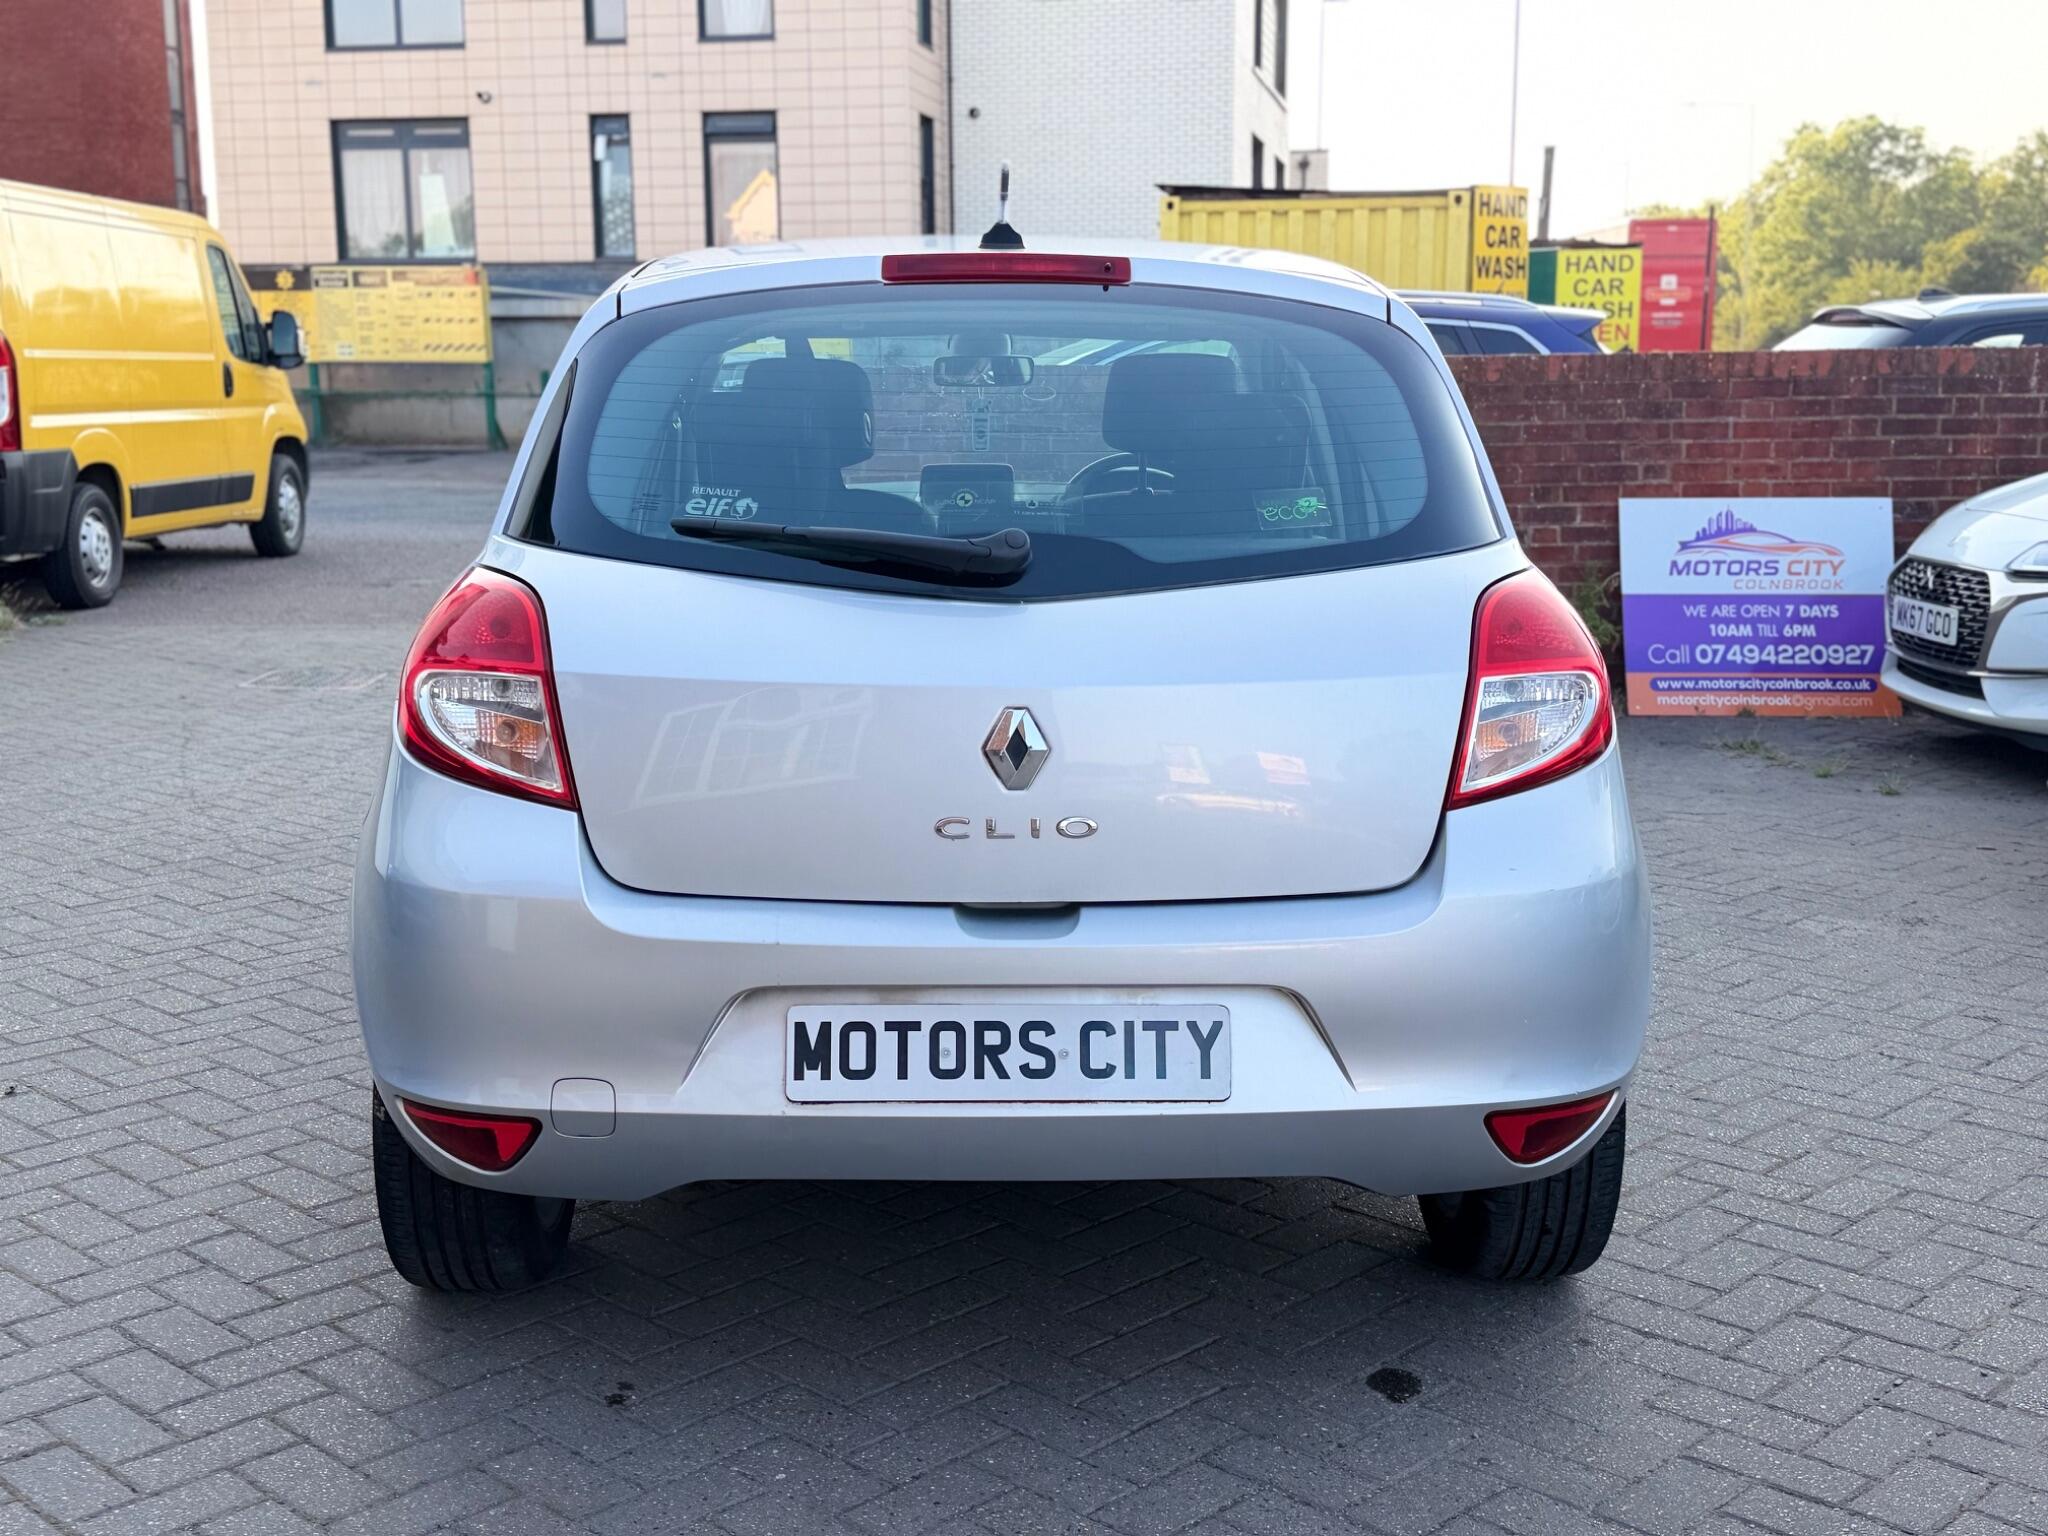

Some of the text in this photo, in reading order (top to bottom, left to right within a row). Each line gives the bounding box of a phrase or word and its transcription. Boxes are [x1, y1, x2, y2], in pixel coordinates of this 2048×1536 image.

[1479, 193, 1527, 216] HAND
[1485, 225, 1521, 249] CAR
[1476, 256, 1527, 279] WASH
[1565, 255, 1634, 273] HAND
[1573, 278, 1624, 297] CAR
[1561, 301, 1633, 320] SH
[1597, 323, 1630, 342] EN
[692, 486, 741, 497] RENAULT
[685, 497, 732, 516] elf
[1669, 560, 1845, 576] MOTORS CITY
[1733, 579, 1844, 590] COLNBROOK
[1683, 604, 1839, 618] WE ARE OPEN 7 DAYS
[1709, 624, 1816, 637] 10AM TILL 6PM
[1647, 643, 1876, 665] Call 07494220927
[1656, 677, 1871, 692] www.motorscitycolnbrook.co.uk
[1656, 693, 1874, 710] motorcitycolnbrook@gmail.com
[934, 816, 1099, 840] CLIO
[793, 1020, 1224, 1081] MOTORS CITY
